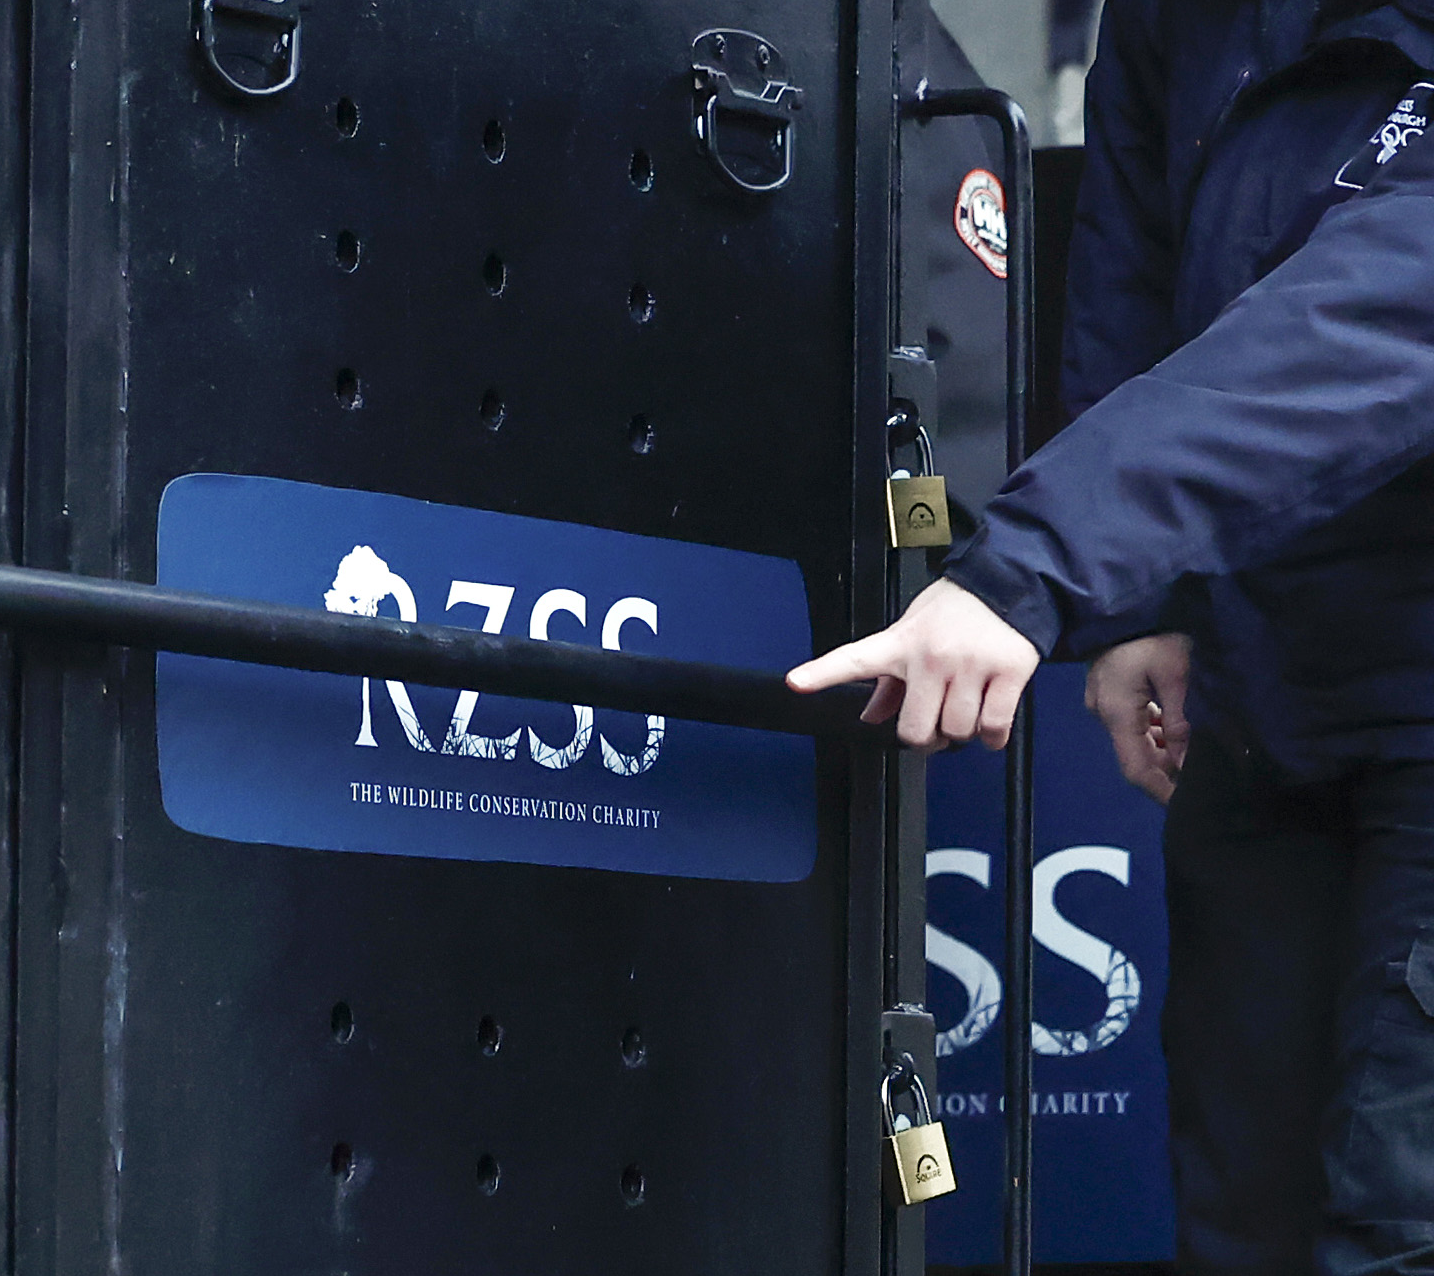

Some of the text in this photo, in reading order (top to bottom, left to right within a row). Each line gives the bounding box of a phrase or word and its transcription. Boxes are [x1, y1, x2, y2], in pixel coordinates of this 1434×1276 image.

[323, 545, 666, 776] RZSS
[350, 782, 661, 829] THE WILDLIFE CONSERVATION CHARITY
[925, 844, 1142, 1058] SS
